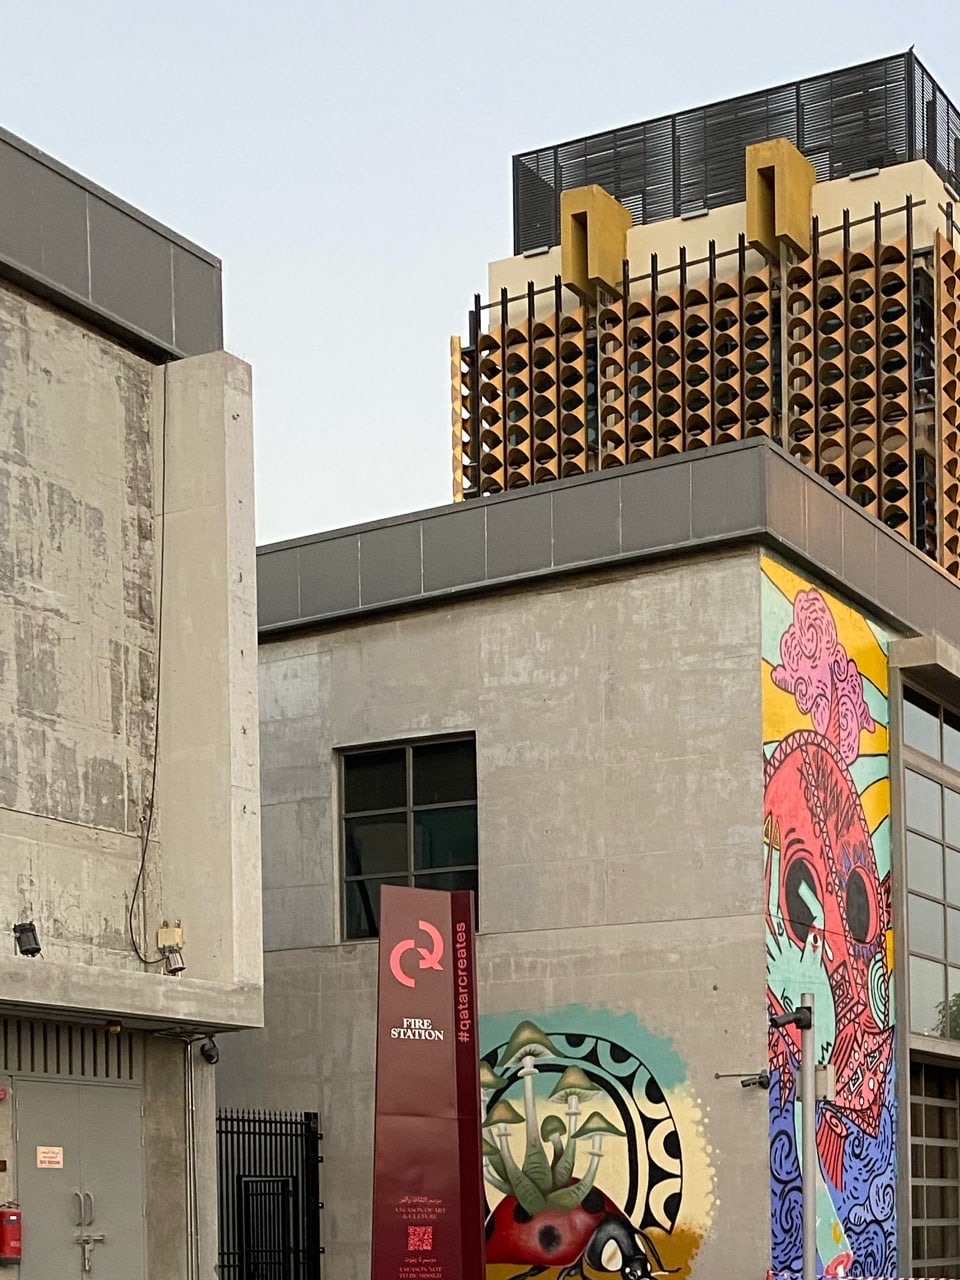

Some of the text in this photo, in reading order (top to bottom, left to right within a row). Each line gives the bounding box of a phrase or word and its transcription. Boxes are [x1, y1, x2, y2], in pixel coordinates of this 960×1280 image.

[455, 922, 471, 1043] #qatarcreates
[403, 1018, 432, 1029] FIRE
[391, 1027, 444, 1041] STATION
